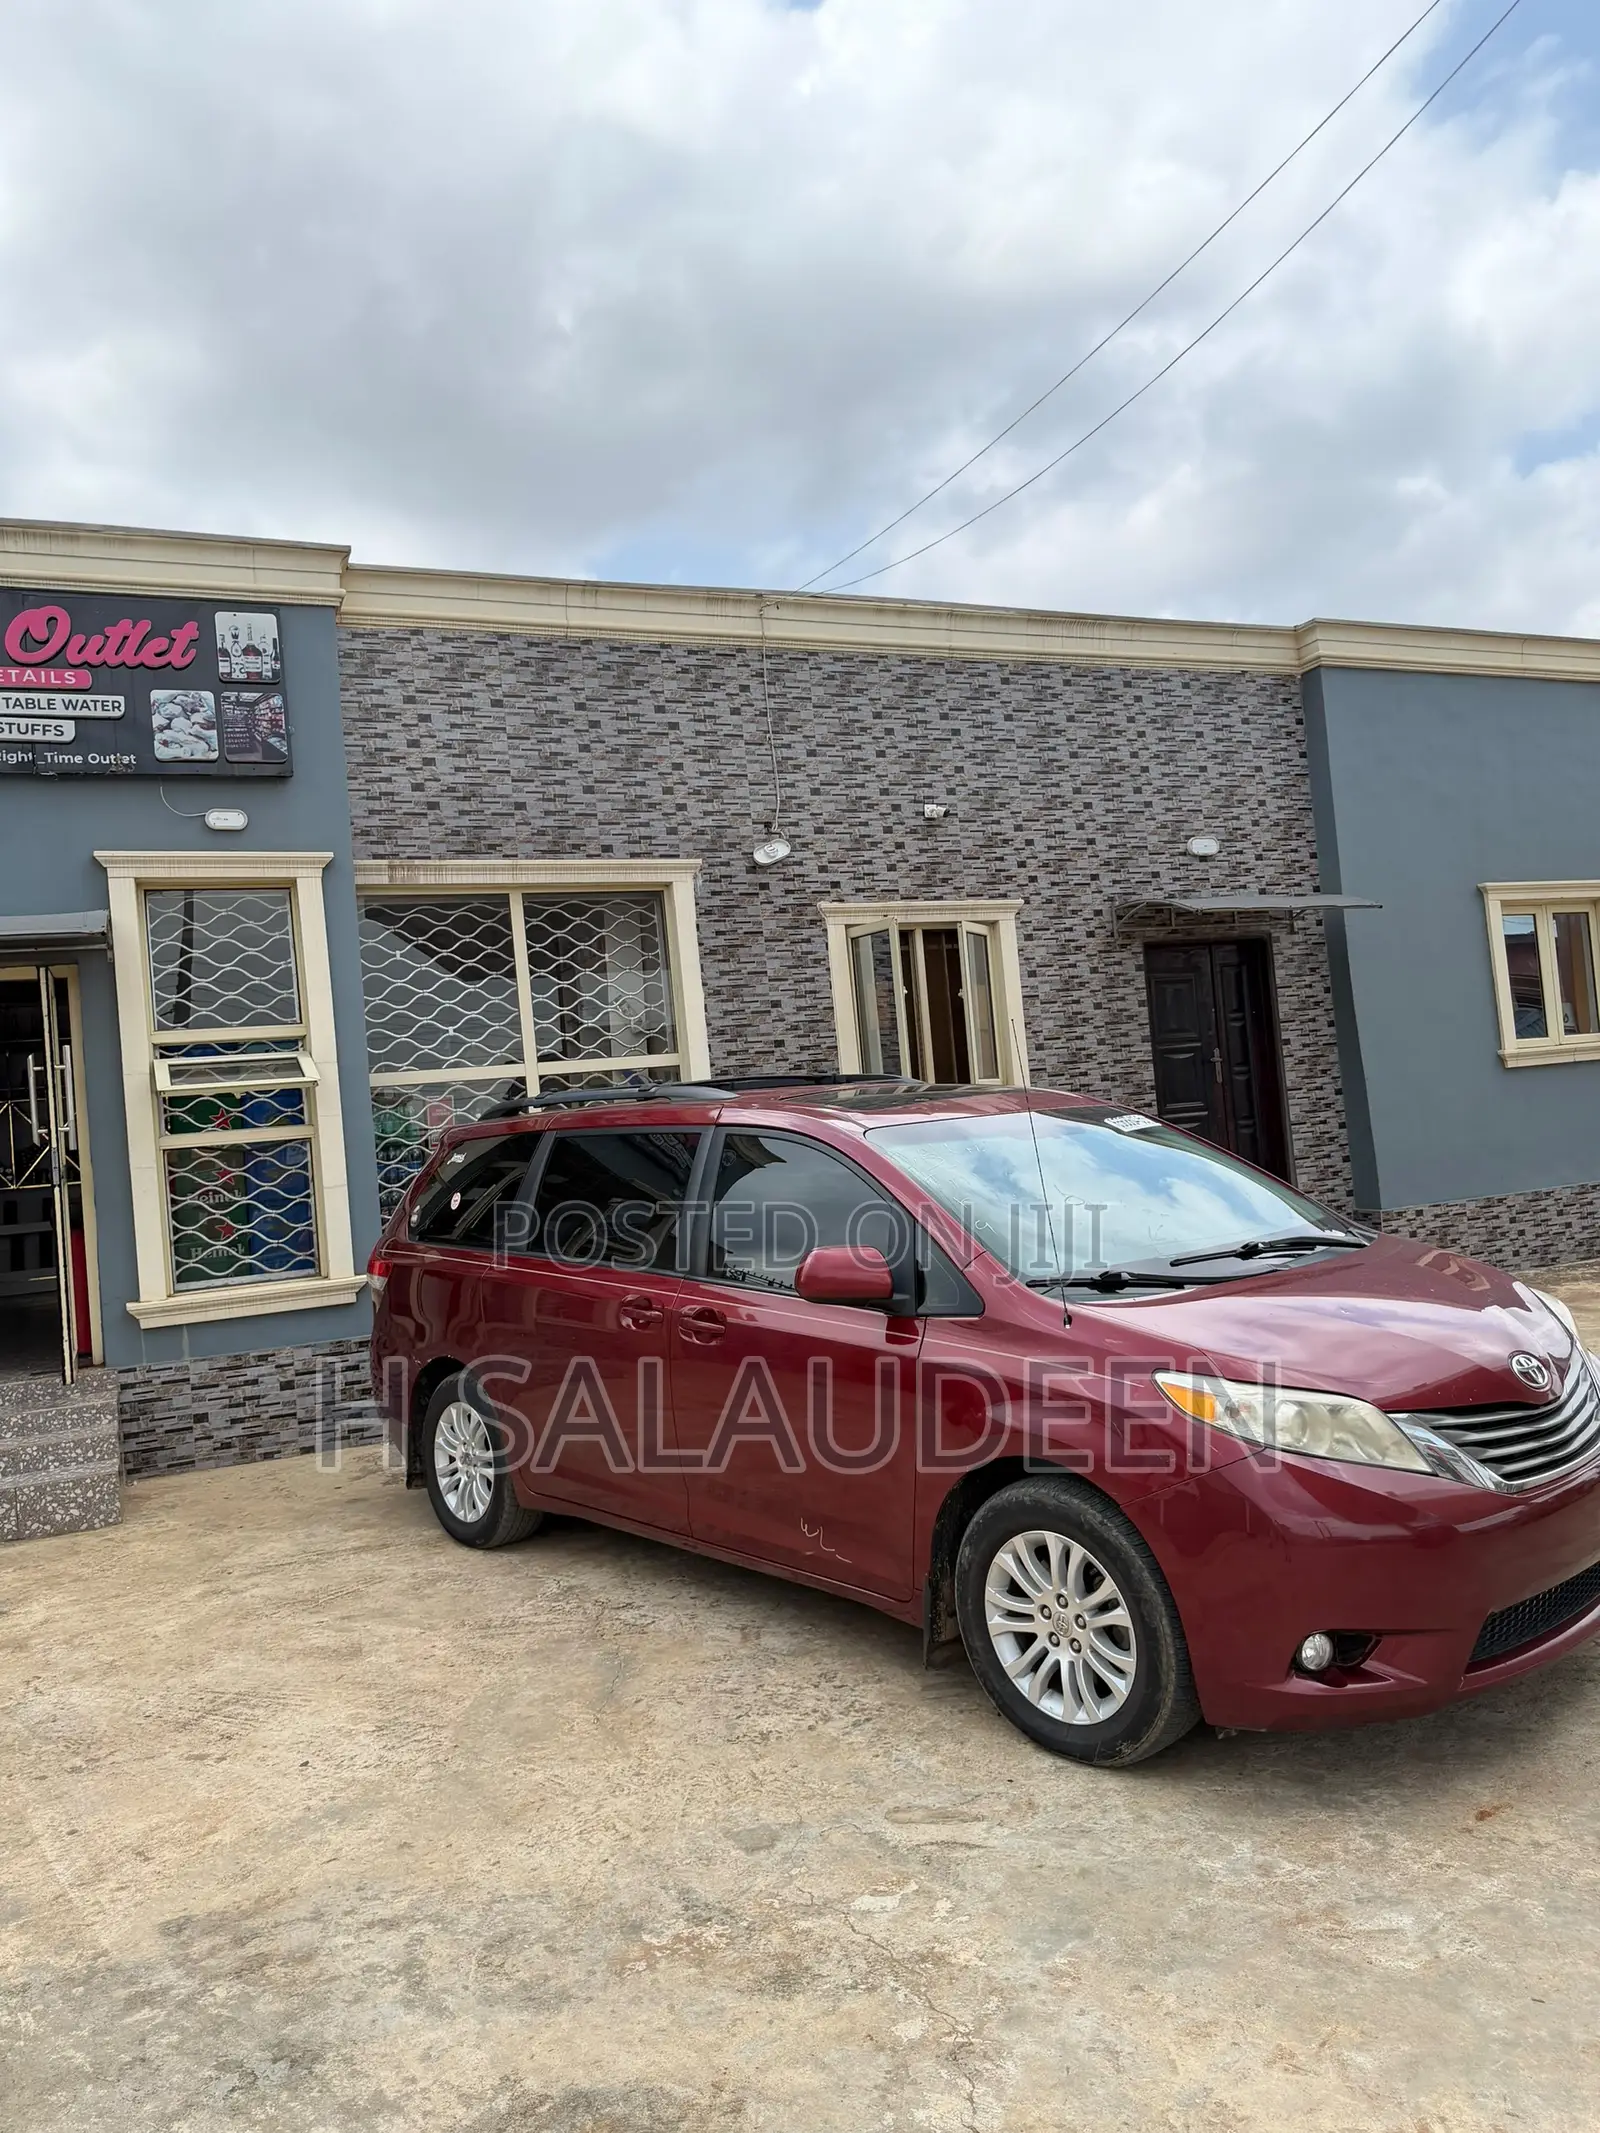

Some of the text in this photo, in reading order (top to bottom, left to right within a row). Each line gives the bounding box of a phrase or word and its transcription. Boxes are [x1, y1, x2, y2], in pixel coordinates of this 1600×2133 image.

[5, 605, 199, 669] Outlet
[2, 697, 122, 712] TABLE WATER
[88, 752, 136, 765] Outlet
